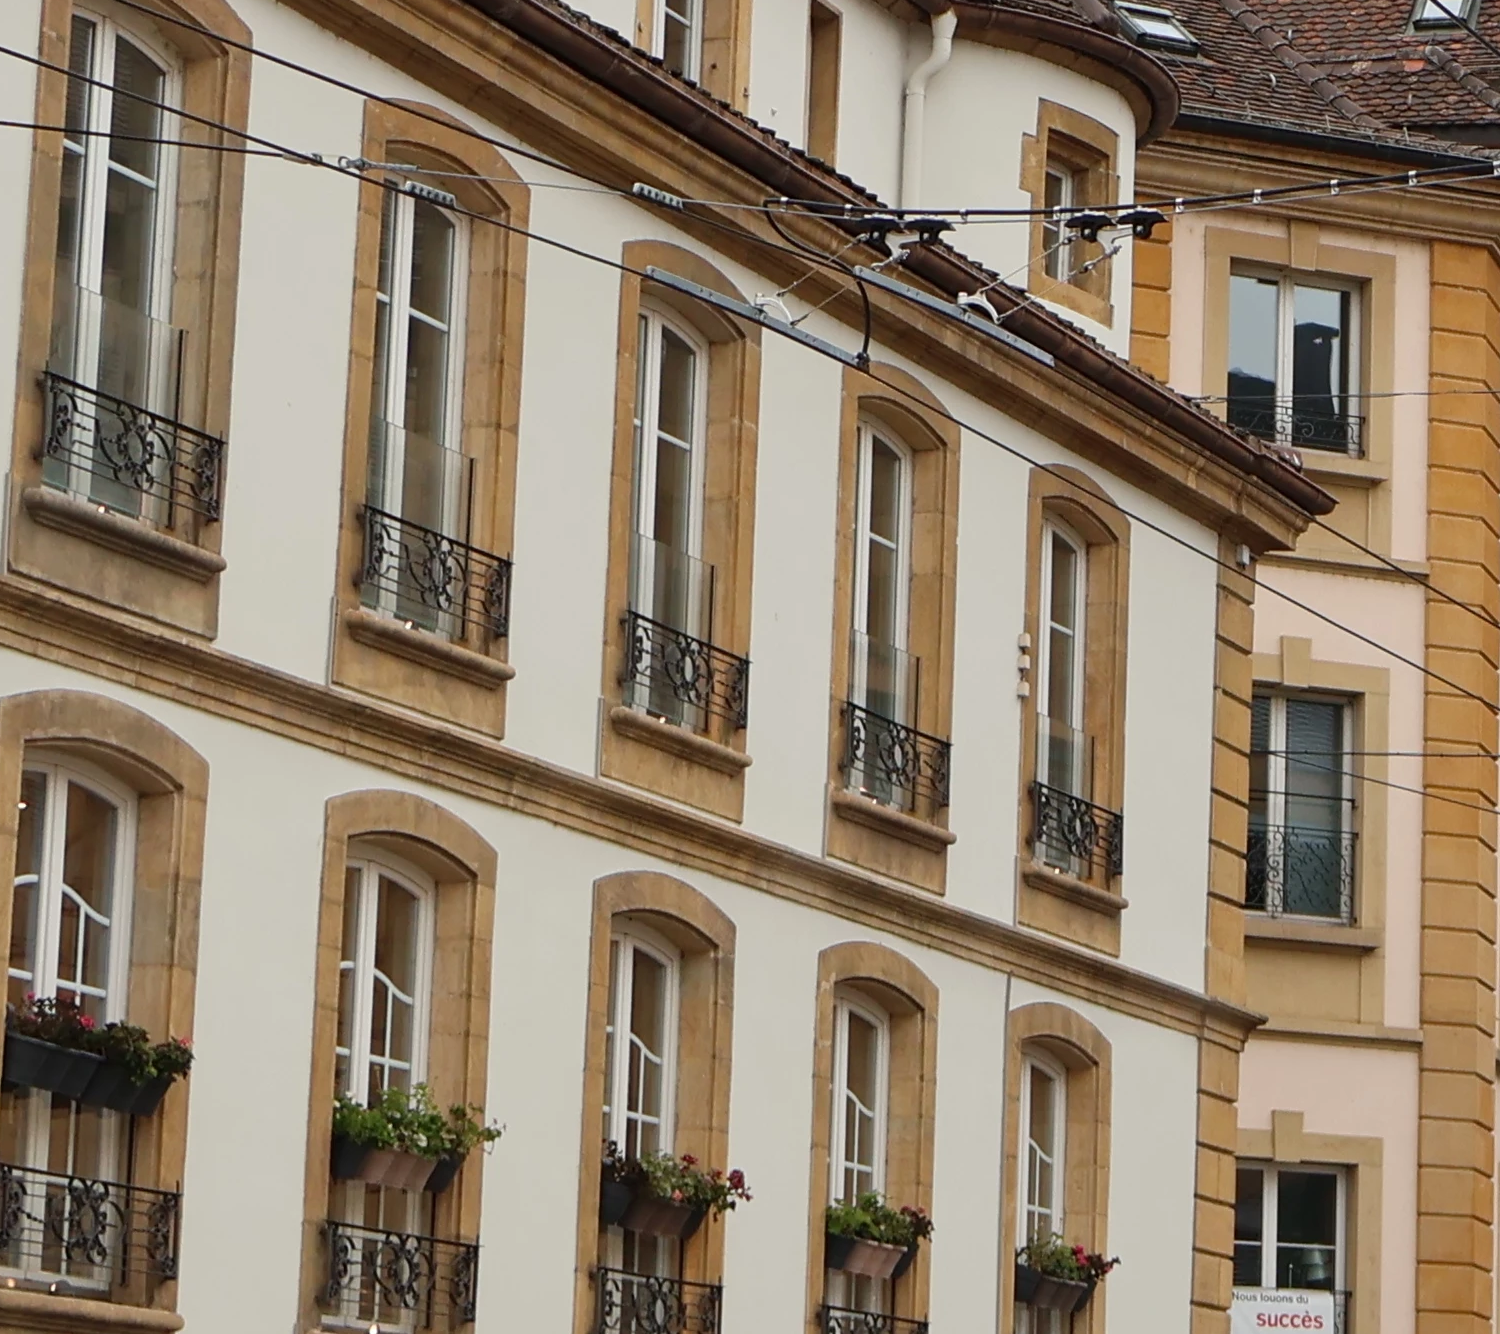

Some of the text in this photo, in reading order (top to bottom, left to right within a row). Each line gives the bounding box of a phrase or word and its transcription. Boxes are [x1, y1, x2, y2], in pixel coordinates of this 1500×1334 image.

[1233, 1291, 1309, 1304] Nous louons du
[1256, 1310, 1324, 1329] succès
